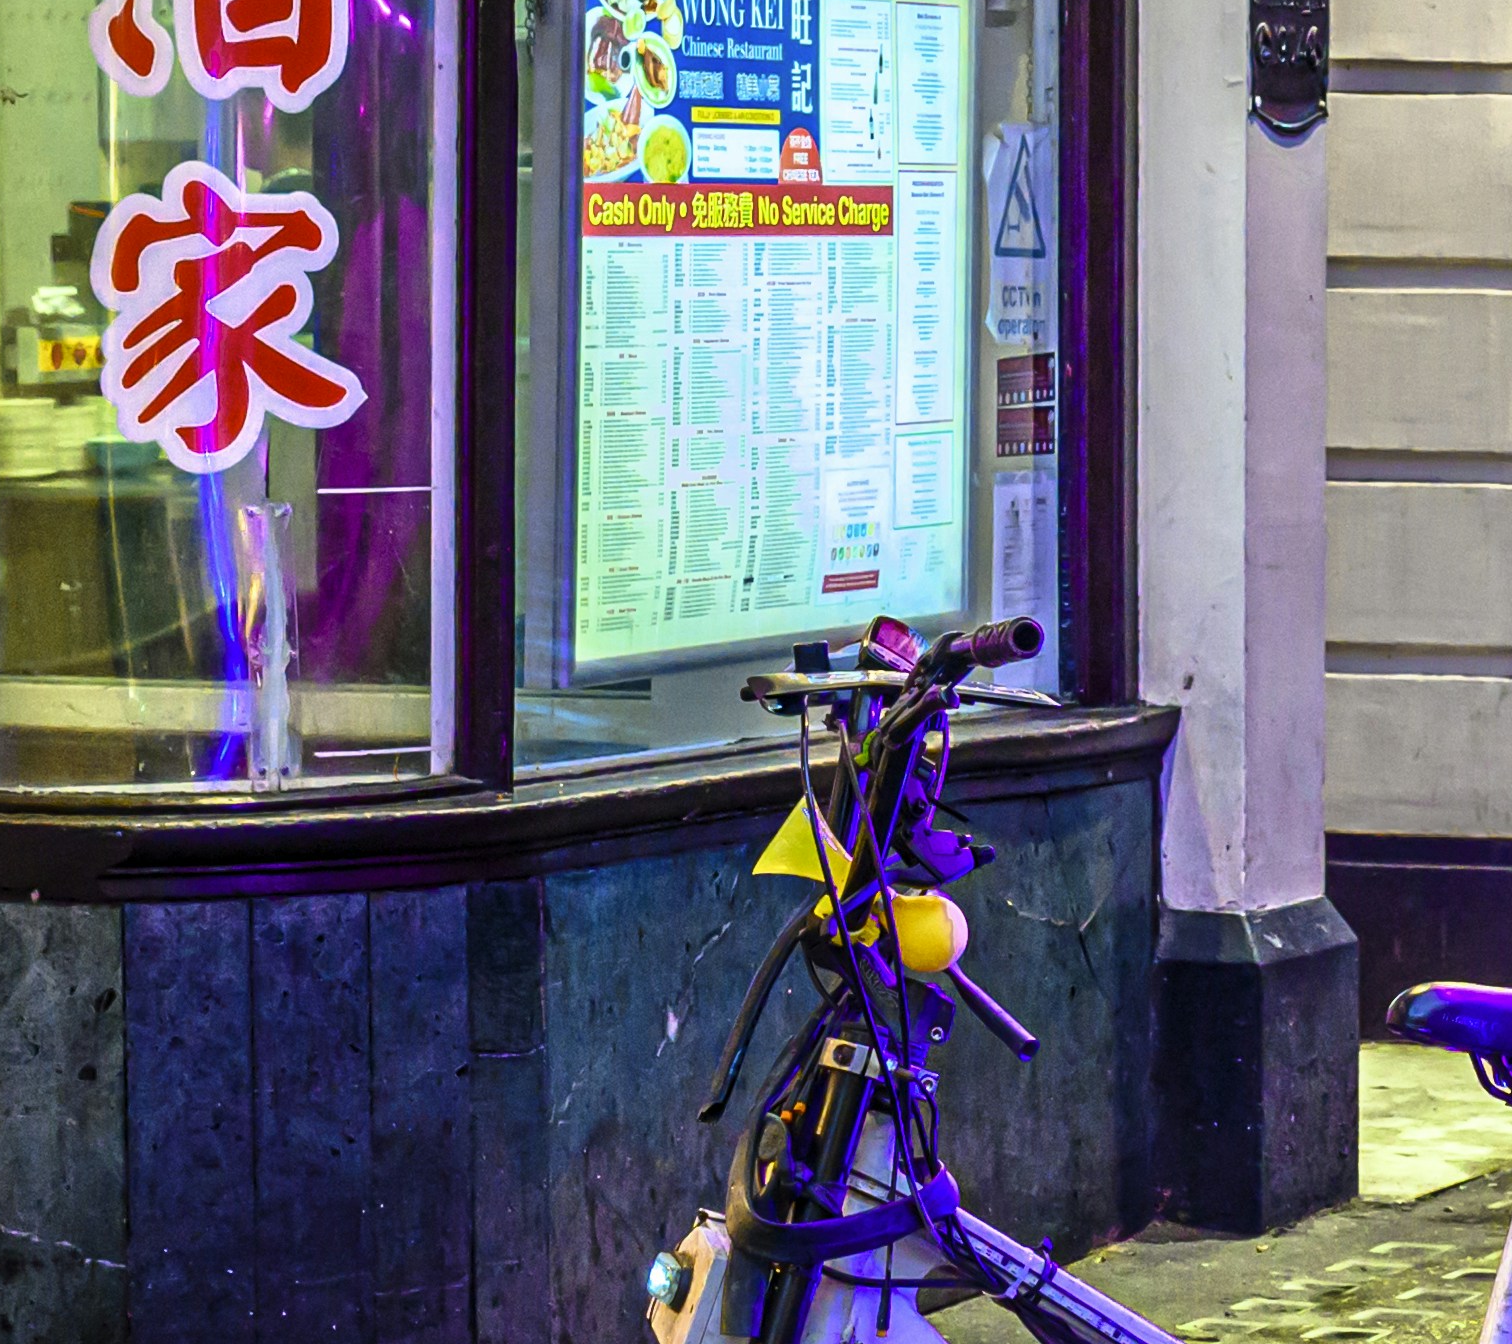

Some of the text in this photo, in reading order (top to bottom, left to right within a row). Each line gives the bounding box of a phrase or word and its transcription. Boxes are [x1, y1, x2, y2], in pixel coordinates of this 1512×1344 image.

[681, 34, 783, 62] Chinese Restaurant
[588, 193, 676, 232] Cash Only
[757, 194, 890, 232] No Service Charge
[998, 318, 1046, 341] opera
